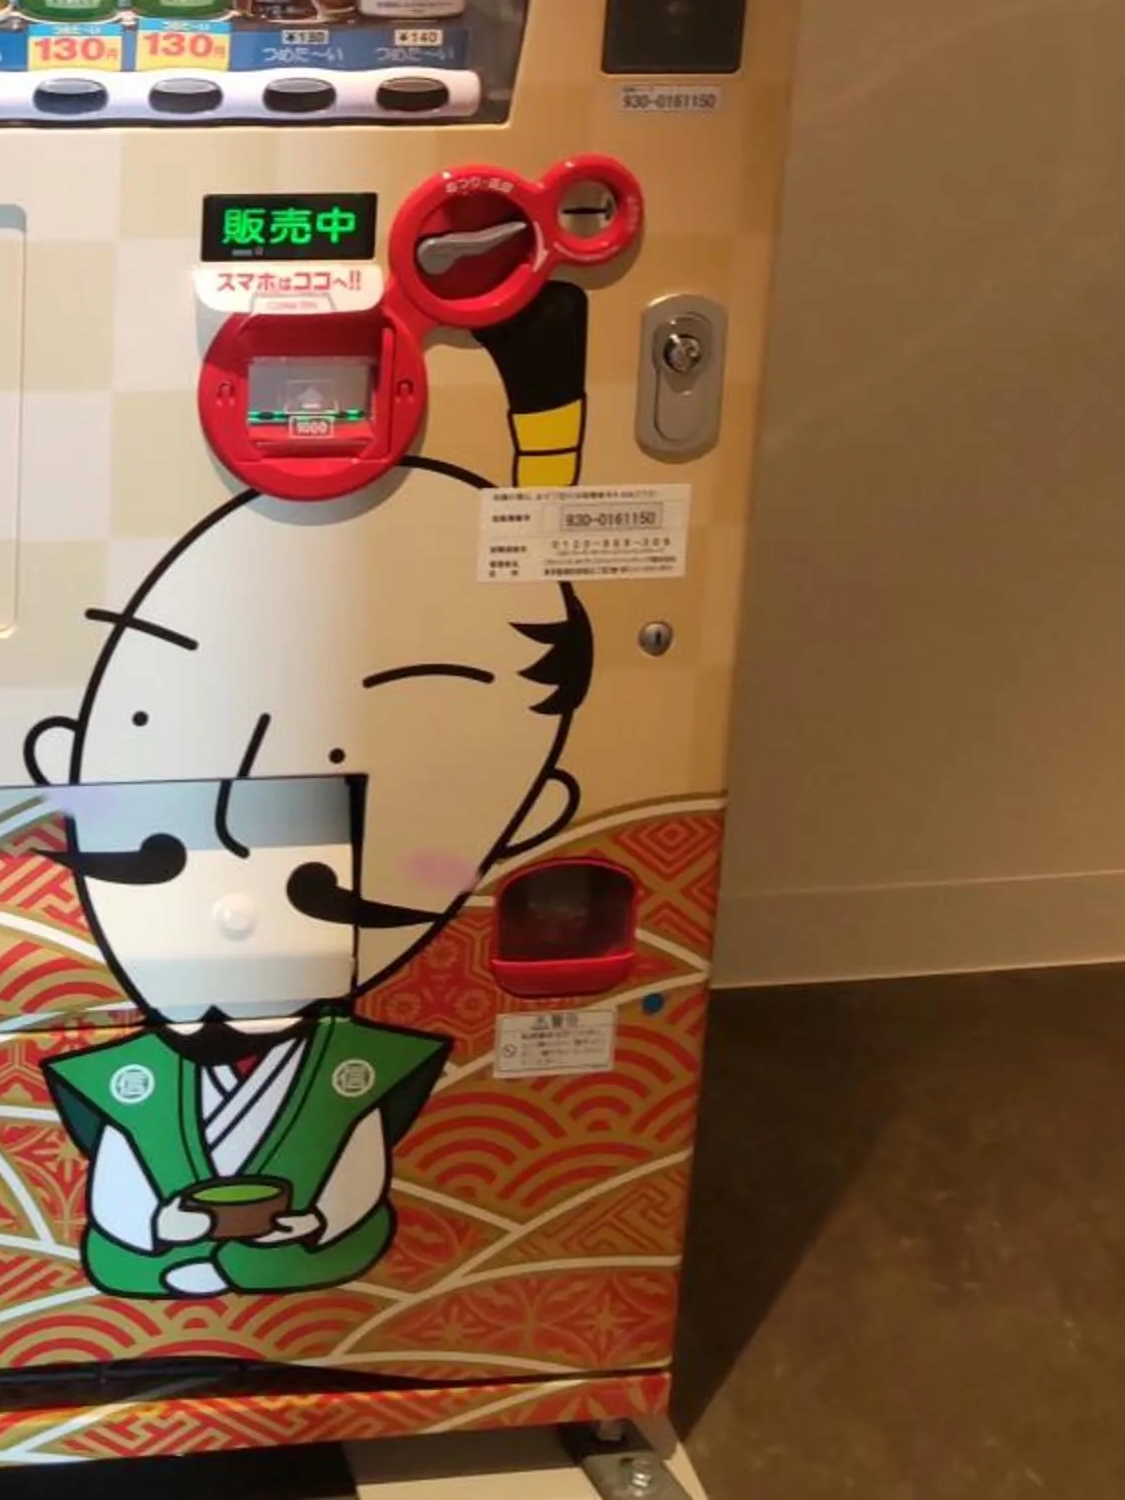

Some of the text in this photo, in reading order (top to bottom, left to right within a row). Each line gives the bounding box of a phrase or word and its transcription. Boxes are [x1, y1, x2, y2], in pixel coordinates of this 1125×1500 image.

[222, 207, 356, 244] 販売中
[217, 270, 361, 291] スマホはココへ!!
